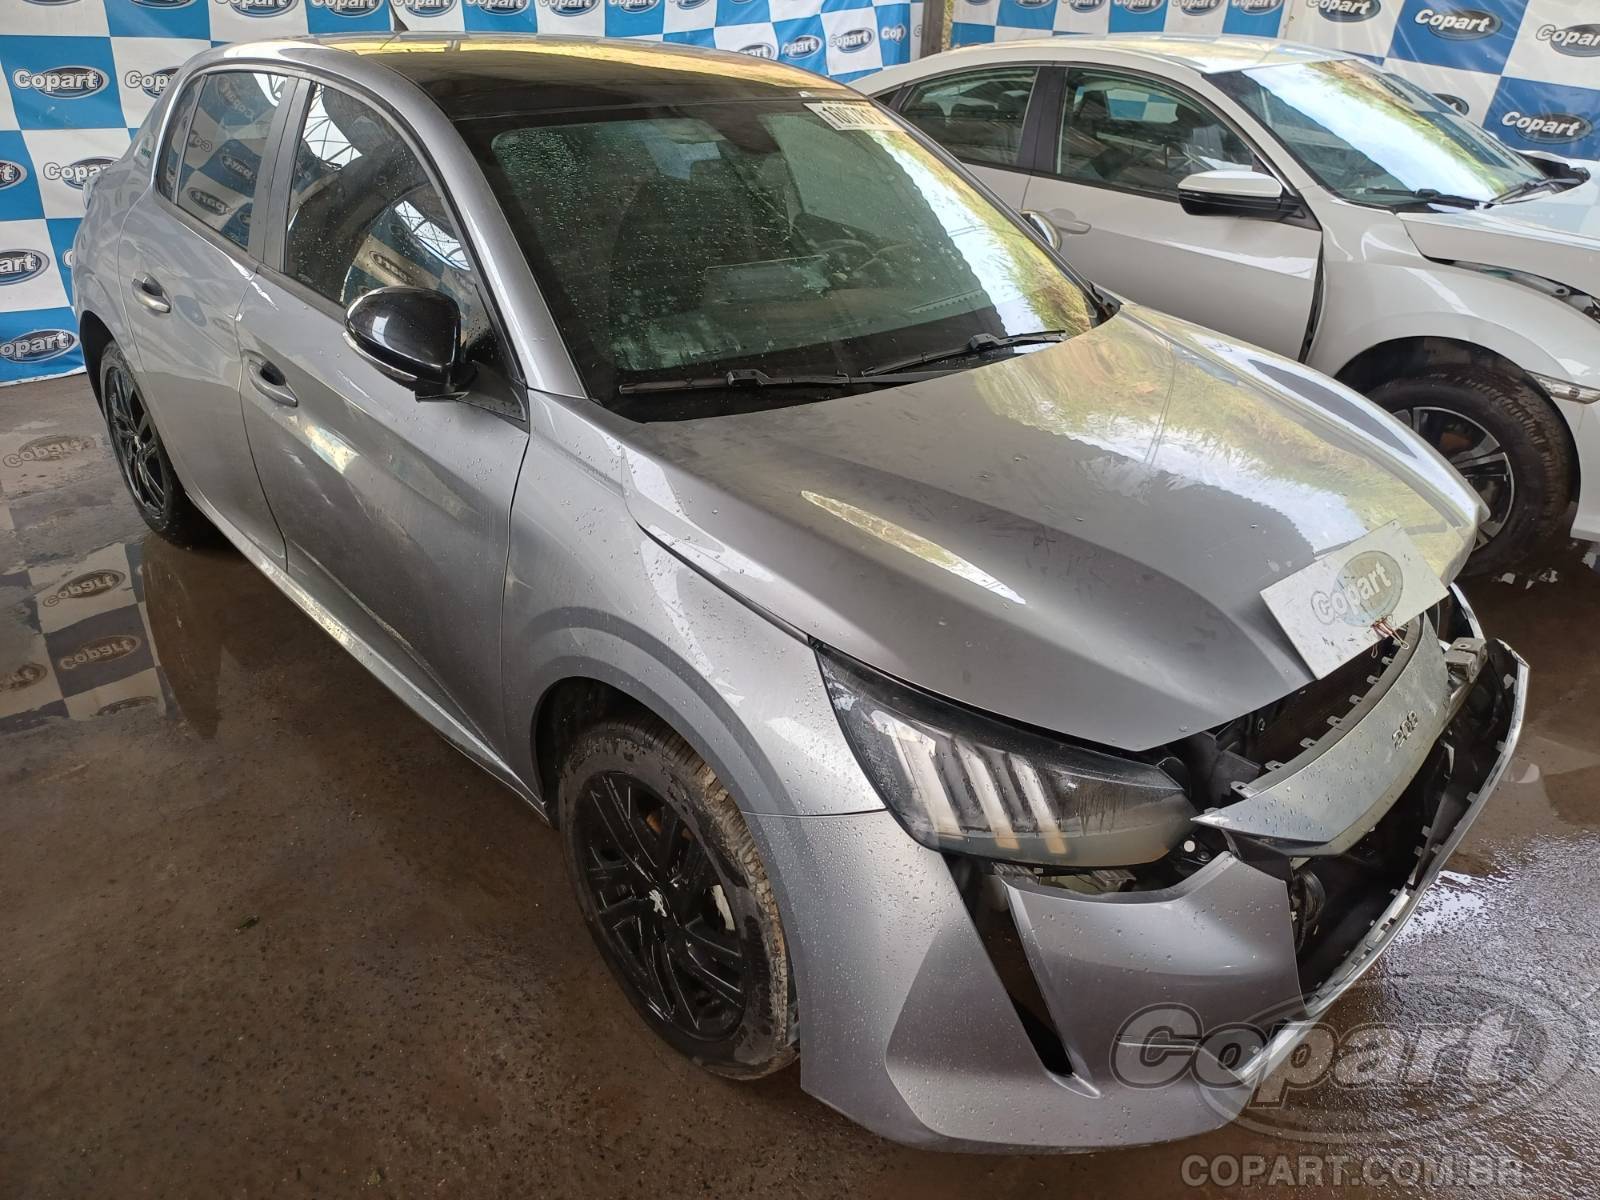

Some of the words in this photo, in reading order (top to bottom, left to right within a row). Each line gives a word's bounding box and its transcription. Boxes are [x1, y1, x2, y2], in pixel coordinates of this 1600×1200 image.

[1415, 9, 1490, 32] Copart
[14, 70, 98, 93] Copart
[1502, 111, 1580, 136] Copart
[1311, 561, 1392, 626] Copart
